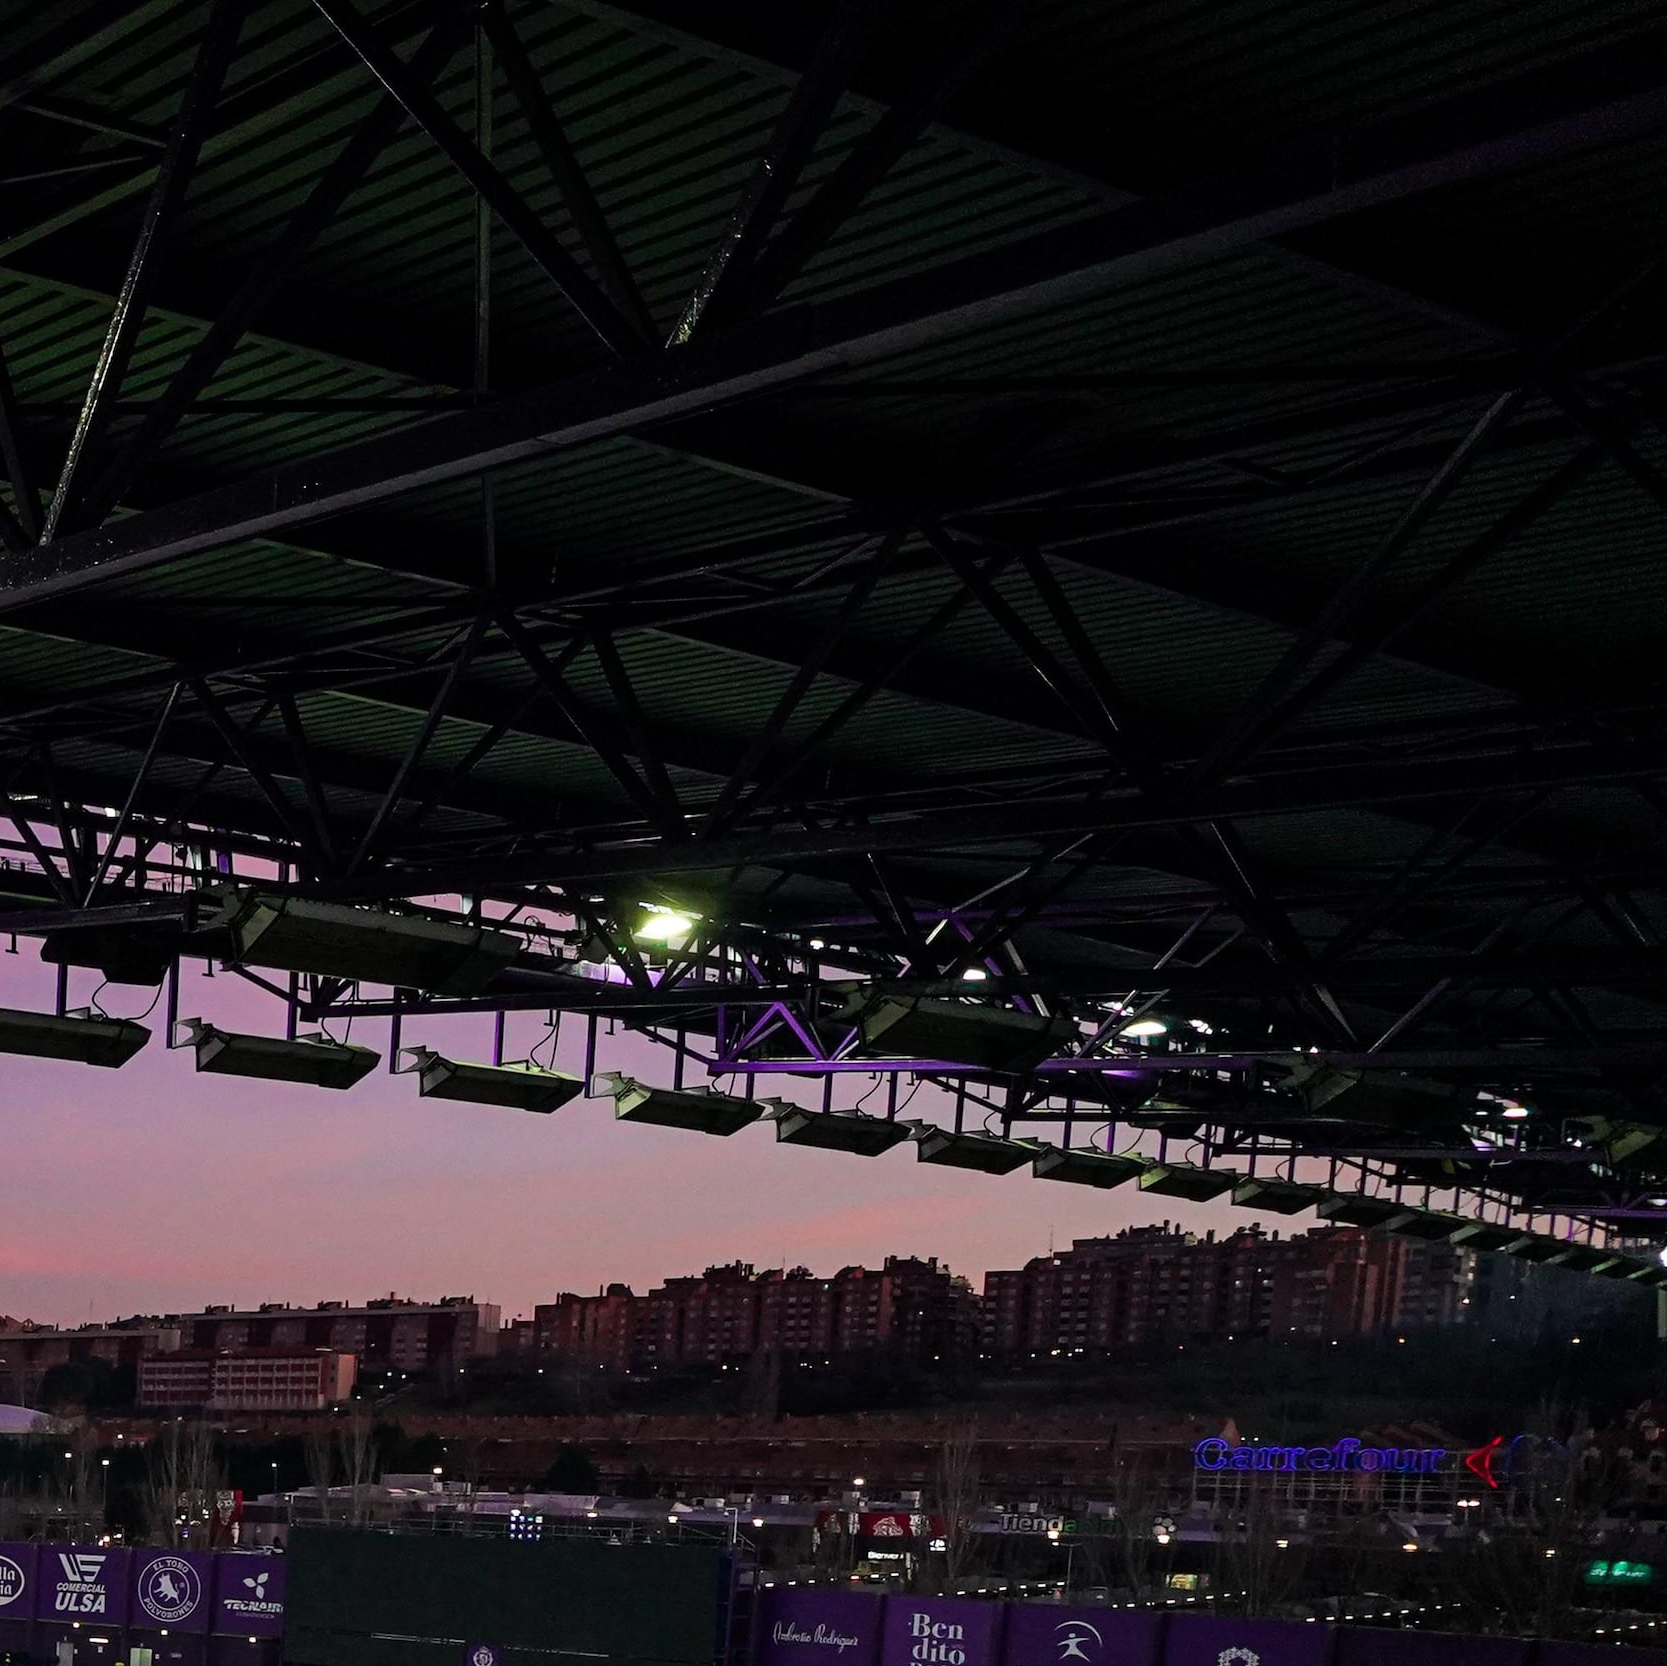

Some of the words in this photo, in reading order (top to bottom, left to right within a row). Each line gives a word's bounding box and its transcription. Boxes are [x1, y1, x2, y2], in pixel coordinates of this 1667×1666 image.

[1194, 1437, 1445, 1473] Carrefour
[153, 1562, 165, 1572] EL
[166, 1560, 189, 1574] TORO
[56, 1582, 106, 1594] COMERCIAL
[55, 1593, 106, 1613] ULSA
[143, 1598, 194, 1618] POLVORONES
[911, 1613, 964, 1640] Ben
[912, 1638, 965, 1666] dito
